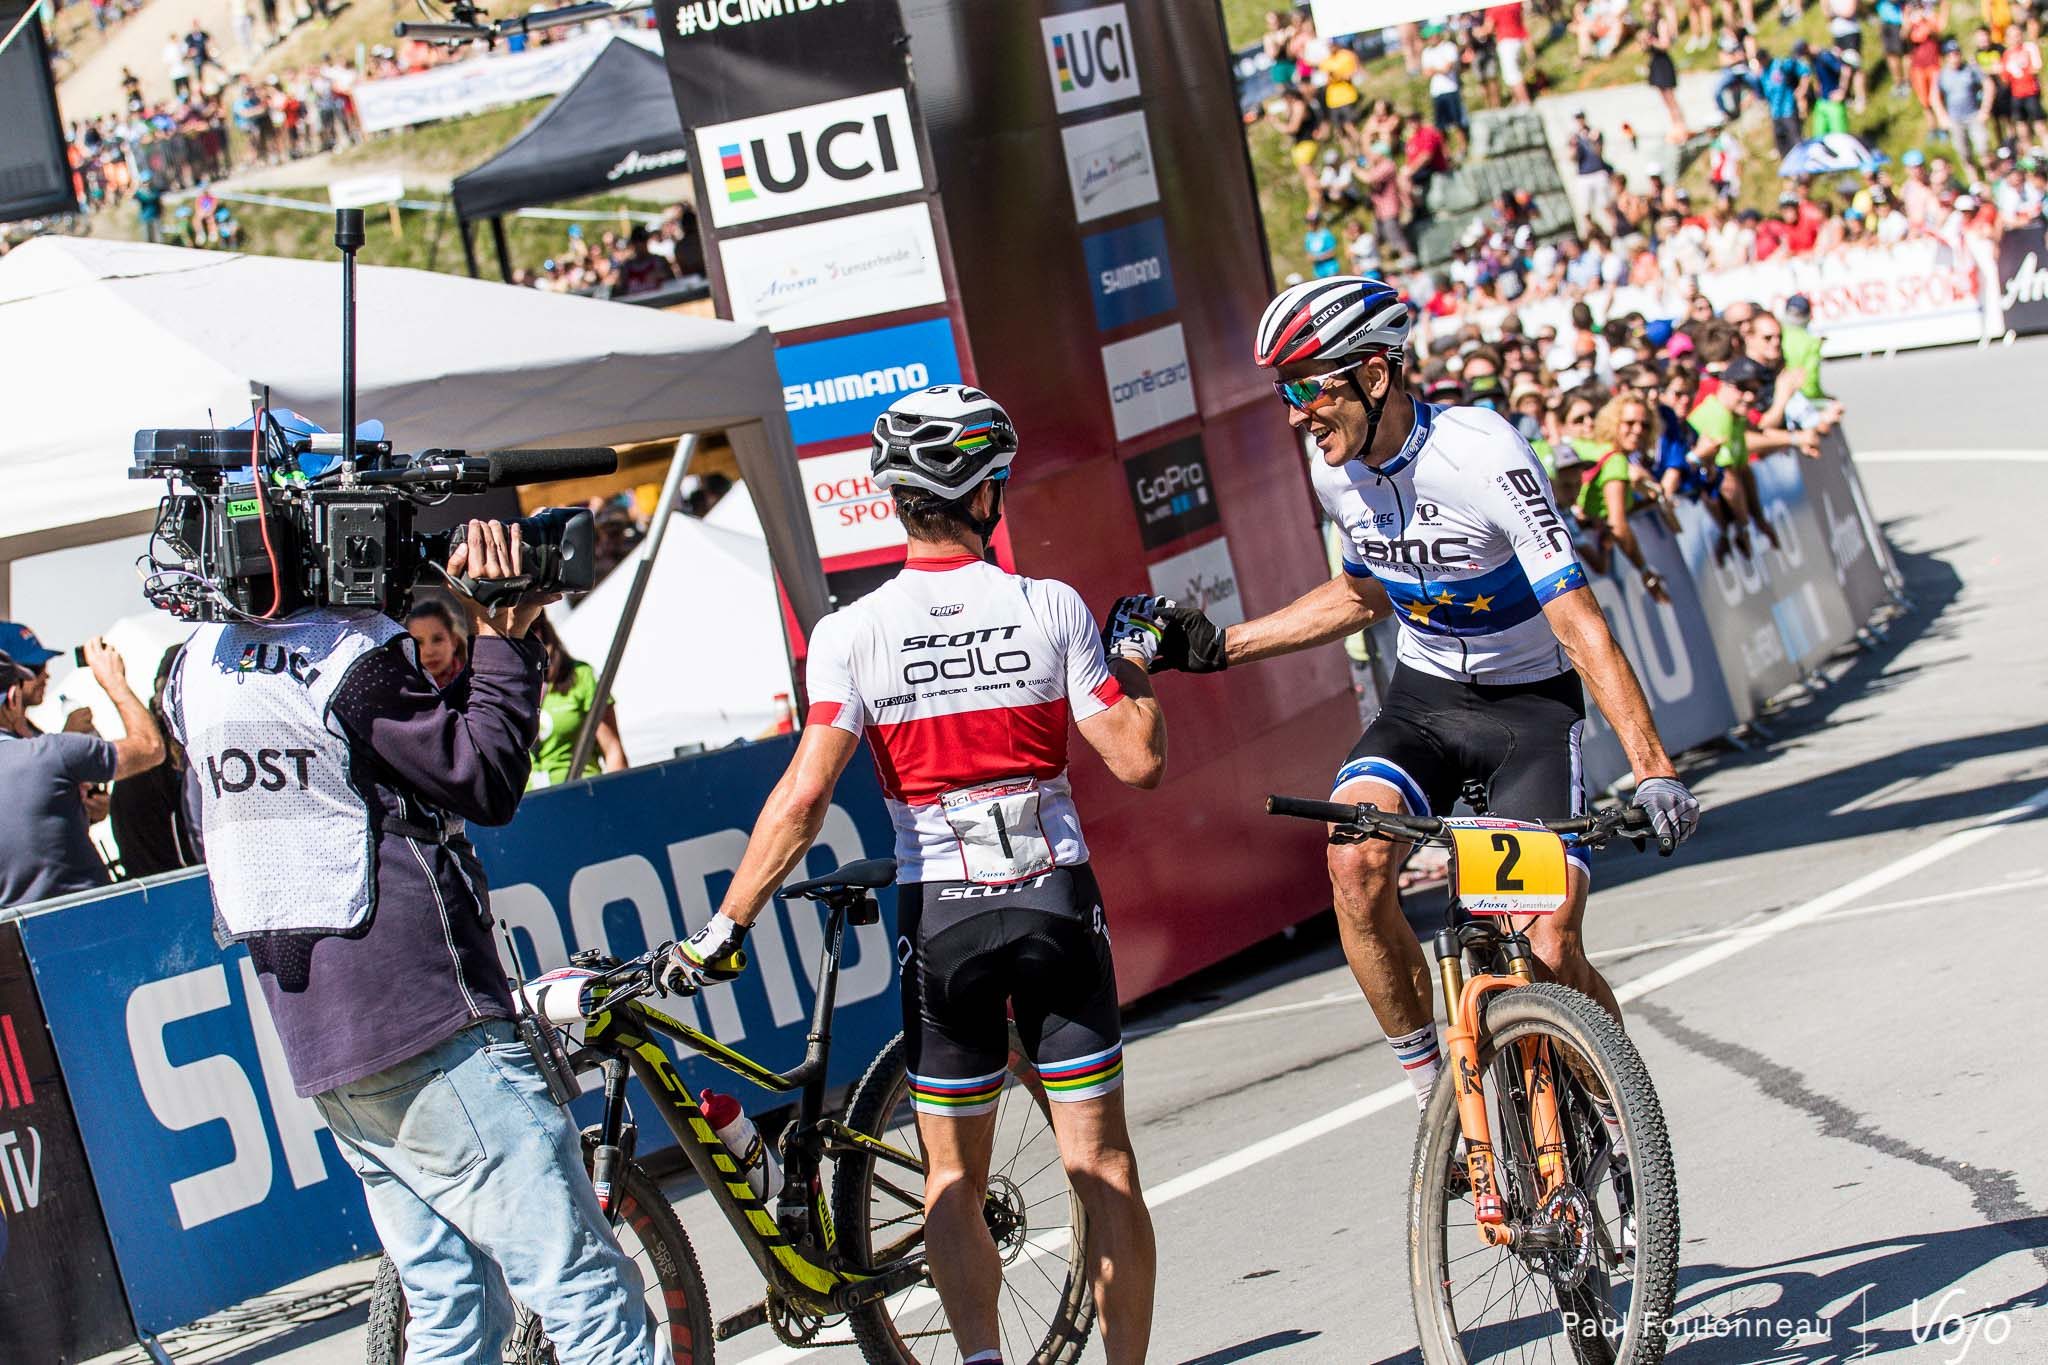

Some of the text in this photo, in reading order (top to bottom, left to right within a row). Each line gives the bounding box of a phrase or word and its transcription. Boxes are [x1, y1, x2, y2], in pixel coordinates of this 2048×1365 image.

[1066, 23, 1130, 88] UCI
[750, 114, 898, 194] UCI
[1101, 256, 1161, 295] SHIMANO
[1313, 302, 1343, 327] GIRO
[1348, 322, 1373, 346] BMC
[782, 362, 930, 412] SHIMANO
[1136, 463, 1204, 505] GoPro
[1372, 512, 1395, 526] UEC
[1496, 475, 1548, 550] SWITZERLAND
[1505, 468, 1573, 553] BMC
[1361, 537, 1471, 565] BMC
[1364, 558, 1462, 575] SWITZERLAND
[901, 625, 1022, 653] SCOTT
[903, 647, 1031, 686] odlo
[1027, 677, 1053, 687] ZURICH
[891, 693, 916, 706] SWISS
[974, 682, 1011, 692] SRAM
[986, 802, 1014, 859] 1
[1491, 833, 1524, 892] 2
[1469, 897, 1509, 910] Arosa
[1470, 1154, 1493, 1198] FOX
